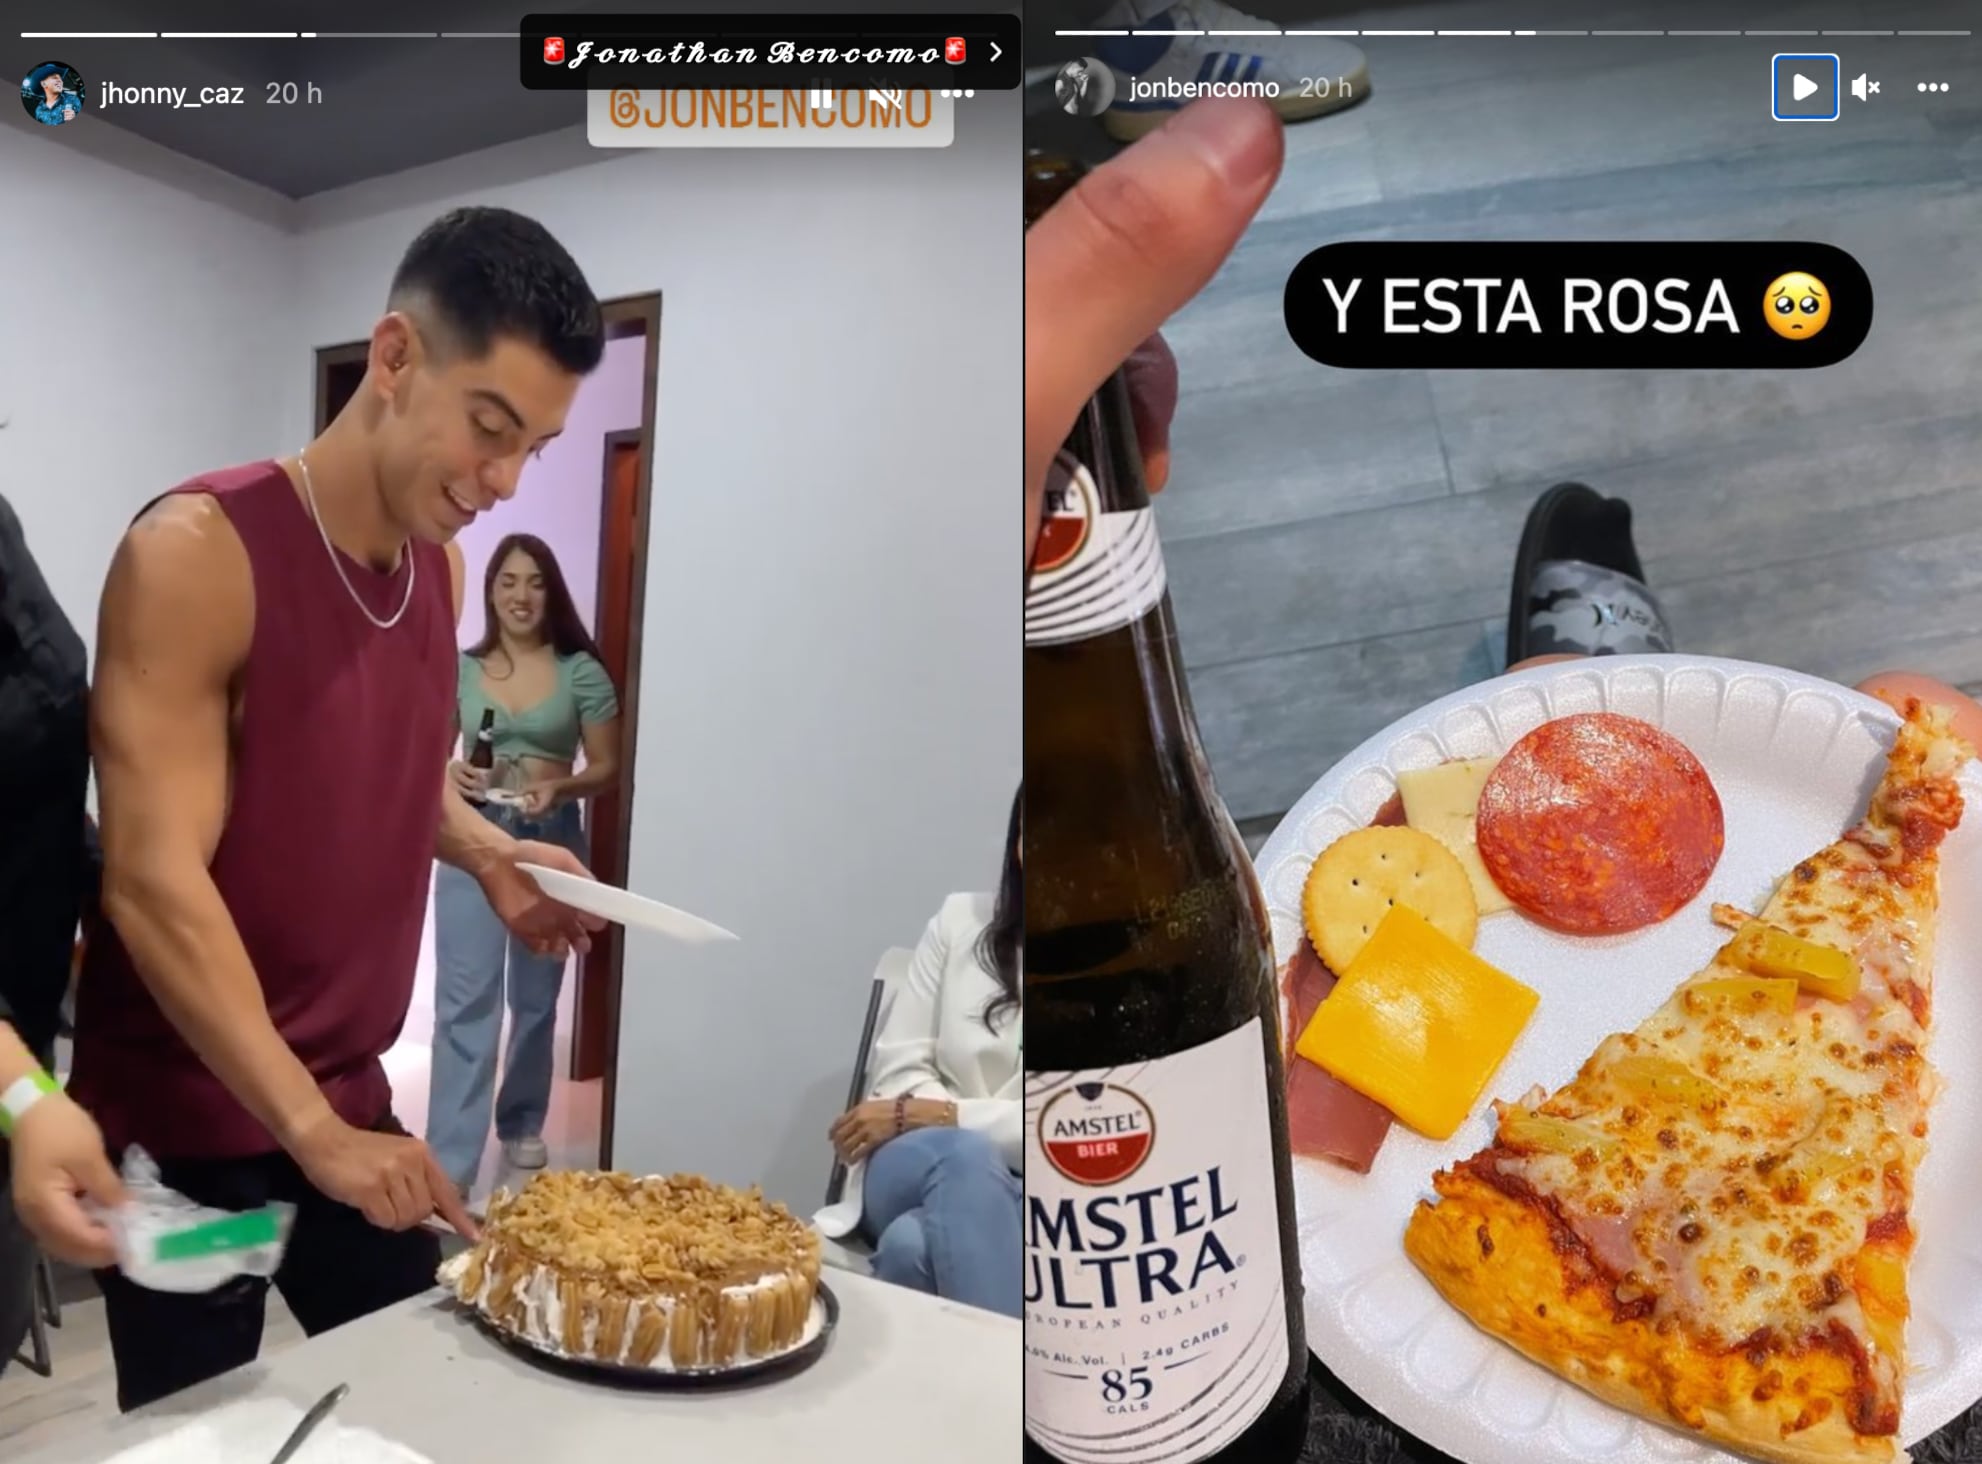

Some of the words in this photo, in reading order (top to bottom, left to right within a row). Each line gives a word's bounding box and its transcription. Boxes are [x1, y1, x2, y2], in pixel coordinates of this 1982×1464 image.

[1054, 1113, 1141, 1137] AMSTEL
[1077, 1142, 1118, 1158] BIER
[1025, 1166, 1238, 1252] MSTEL
[1140, 1280, 1238, 1324] QUALITY
[1142, 1346, 1173, 1360] 2.4g
[1180, 1322, 1230, 1350] CARBS
[1101, 1366, 1153, 1403] 85
[1106, 1401, 1149, 1415] CALS
